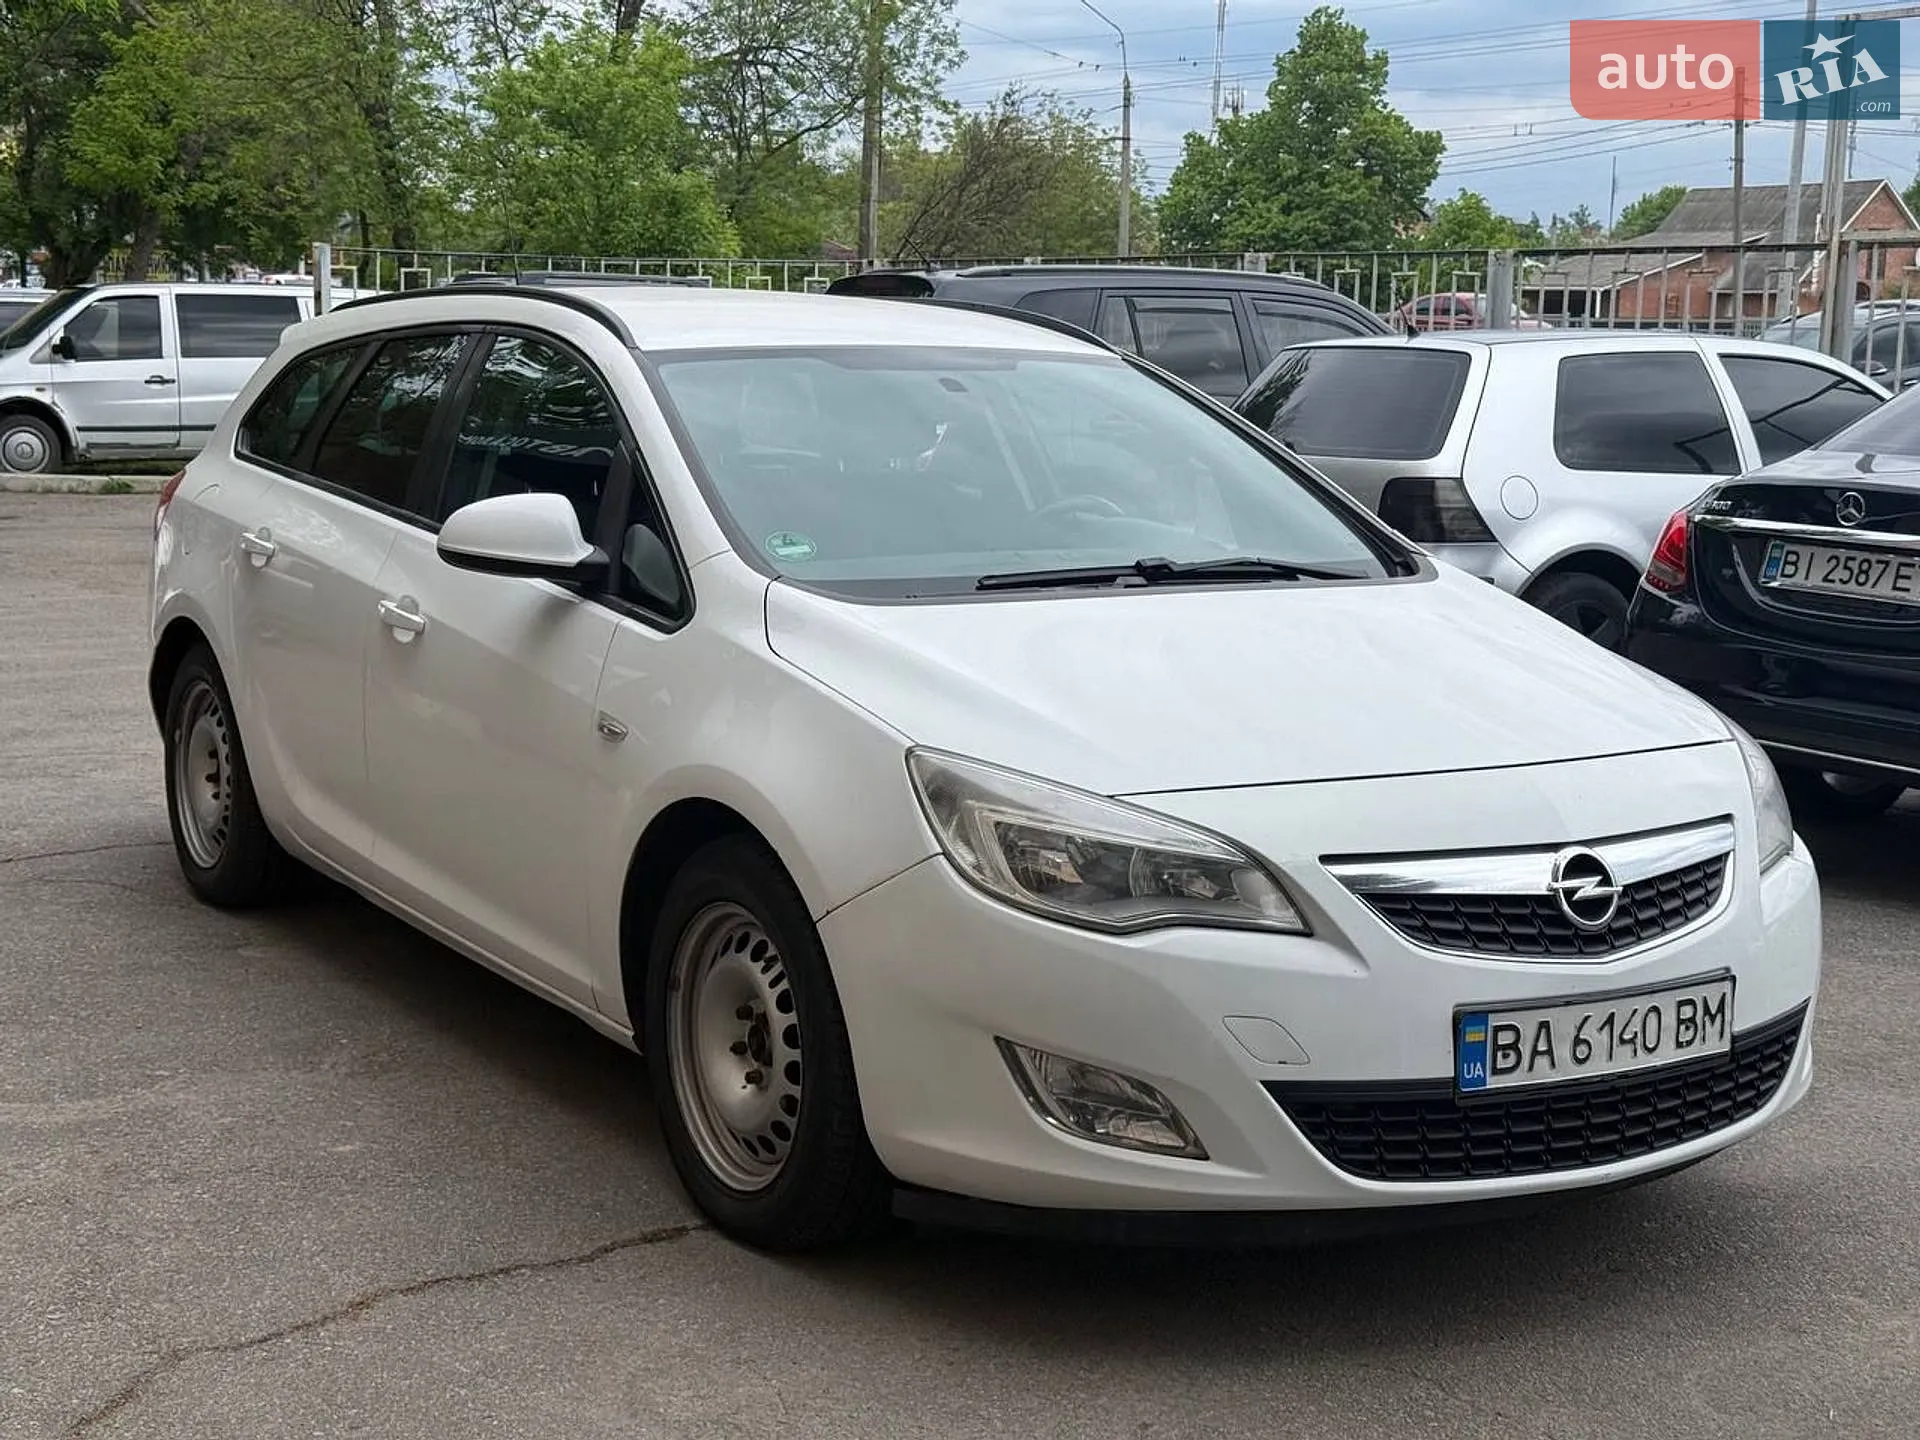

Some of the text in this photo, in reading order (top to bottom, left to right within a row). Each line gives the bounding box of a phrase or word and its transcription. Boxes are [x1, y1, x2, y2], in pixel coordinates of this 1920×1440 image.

[1780, 550, 1920, 592] BI 2587 E
[1491, 992, 1728, 1076] BA 6140 BM
[1463, 1061, 1485, 1080] UA
